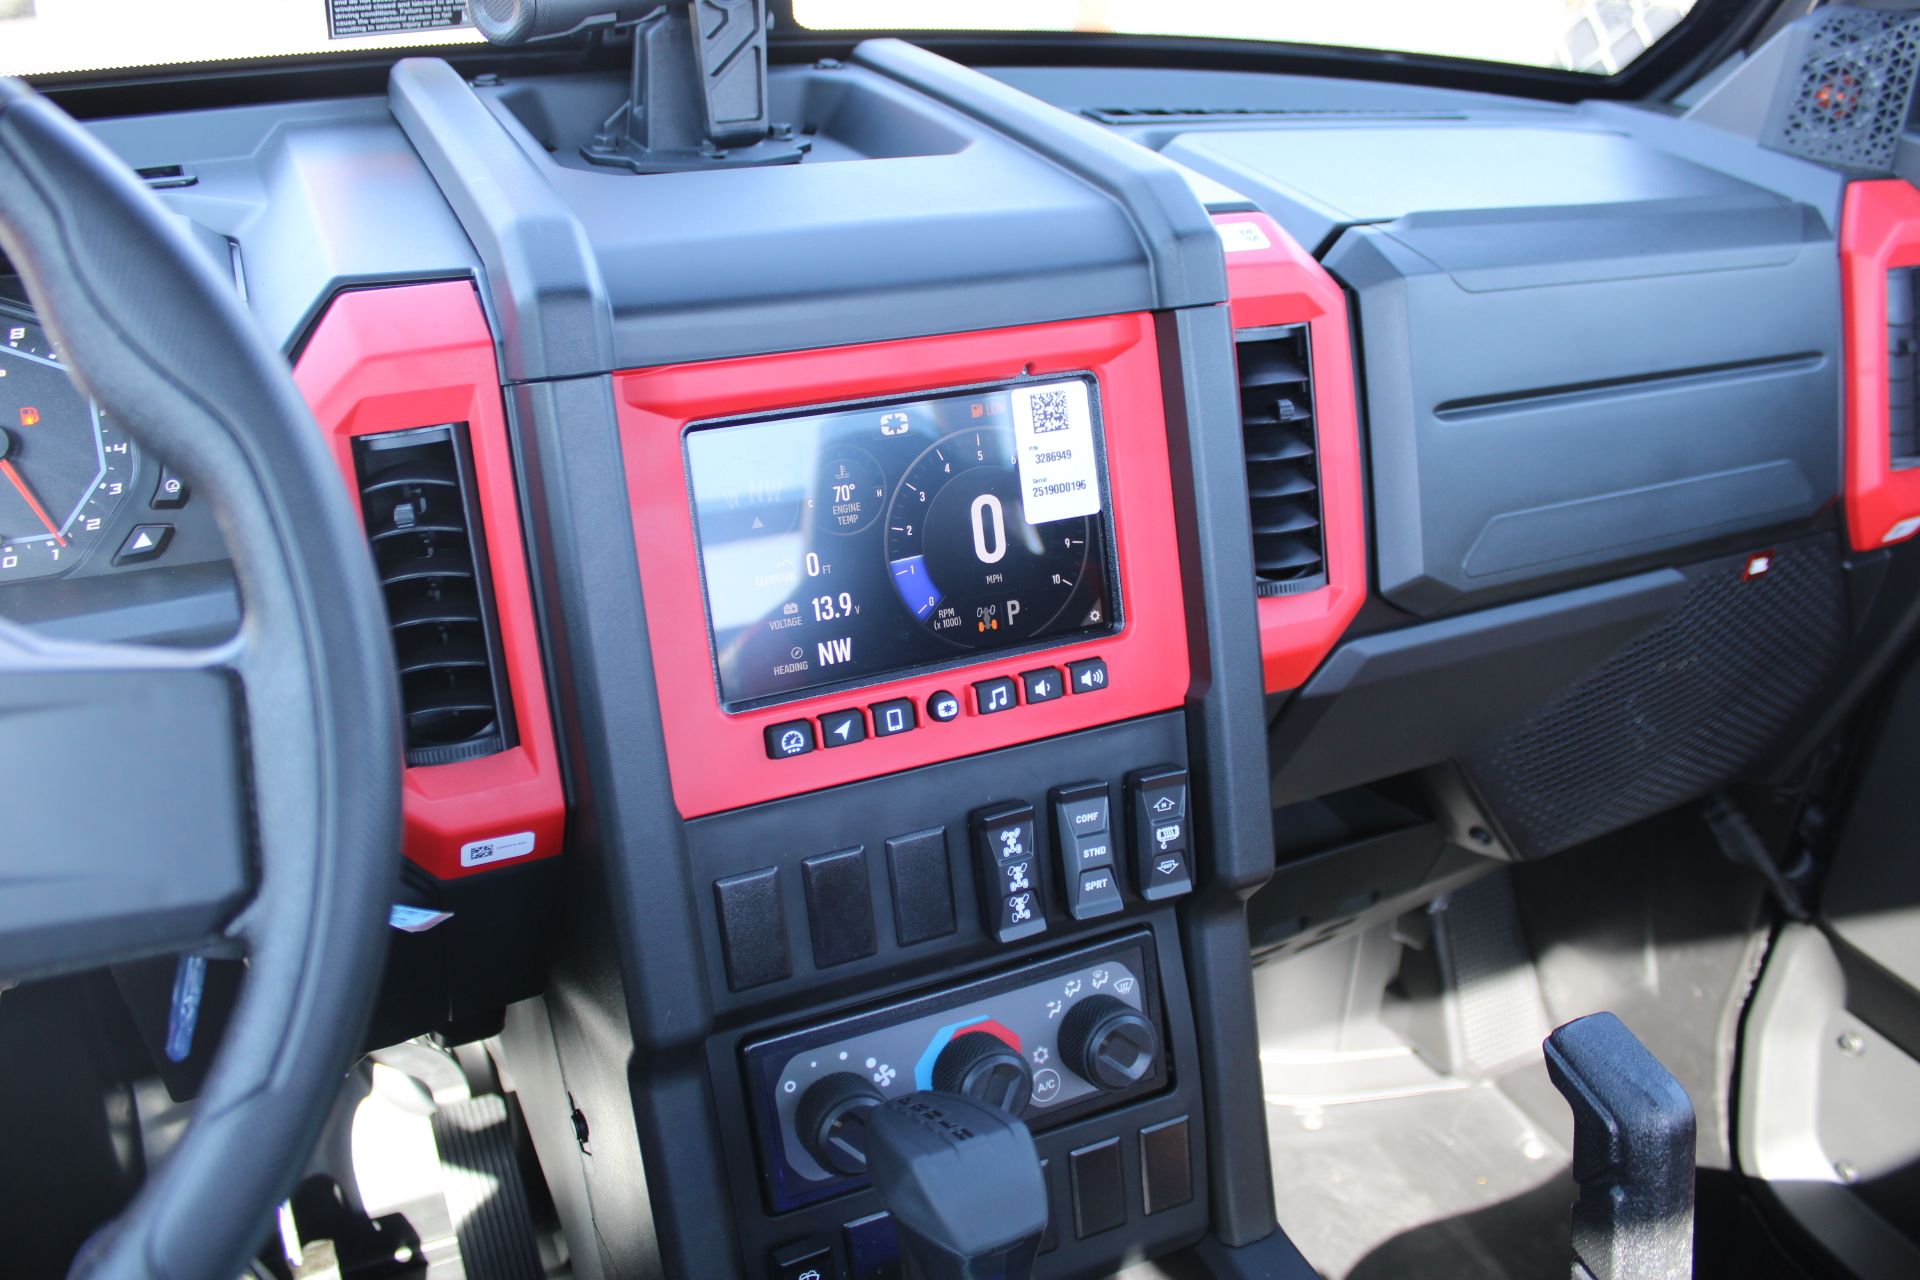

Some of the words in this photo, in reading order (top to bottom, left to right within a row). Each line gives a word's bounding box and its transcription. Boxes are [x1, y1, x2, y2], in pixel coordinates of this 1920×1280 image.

[334, 4, 372, 13] windshield
[373, 2, 396, 10] closed
[335, 12, 360, 20] driving
[360, 10, 399, 18] conditions.
[370, 15, 406, 24] windshield
[336, 25, 366, 34] resulting
[402, 21, 422, 29] injury
[10, 328, 25, 340] 8
[113, 442, 127, 455] 4
[978, 450, 983, 461] 5
[1034, 450, 1072, 464] 3286949
[944, 463, 950, 474] 4
[109, 483, 123, 495] 3
[876, 489, 882, 497] H
[1033, 480, 1086, 498] 25190D0196
[920, 491, 926, 502] 3
[808, 499, 814, 508] C
[832, 502, 861, 515] ENGINE
[86, 518, 101, 531] 2
[837, 514, 859, 526] TEMP
[906, 525, 912, 536] 2
[970, 494, 1007, 564] 0
[1064, 538, 1070, 548] 9
[52, 549, 60, 561] 1
[2, 555, 18, 569] 0
[806, 552, 820, 577] 0
[822, 564, 832, 575] FT
[909, 565, 914, 575] 1
[986, 573, 1003, 584] MPH
[1052, 574, 1061, 584] 10
[812, 592, 852, 621] 13.9
[854, 605, 860, 615] V
[928, 596, 934, 606] 0
[938, 608, 955, 618] RPM
[1006, 600, 1021, 625] P
[769, 616, 802, 630] VOLTAGE
[934, 620, 942, 630] (x
[942, 616, 962, 628] 1000)
[818, 637, 851, 666] NW
[774, 661, 808, 676] HEADING
[1076, 812, 1099, 824] COMF
[1083, 846, 1107, 858] STND
[1085, 879, 1108, 891] SPRT
[1038, 1080, 1055, 1093] A/C
